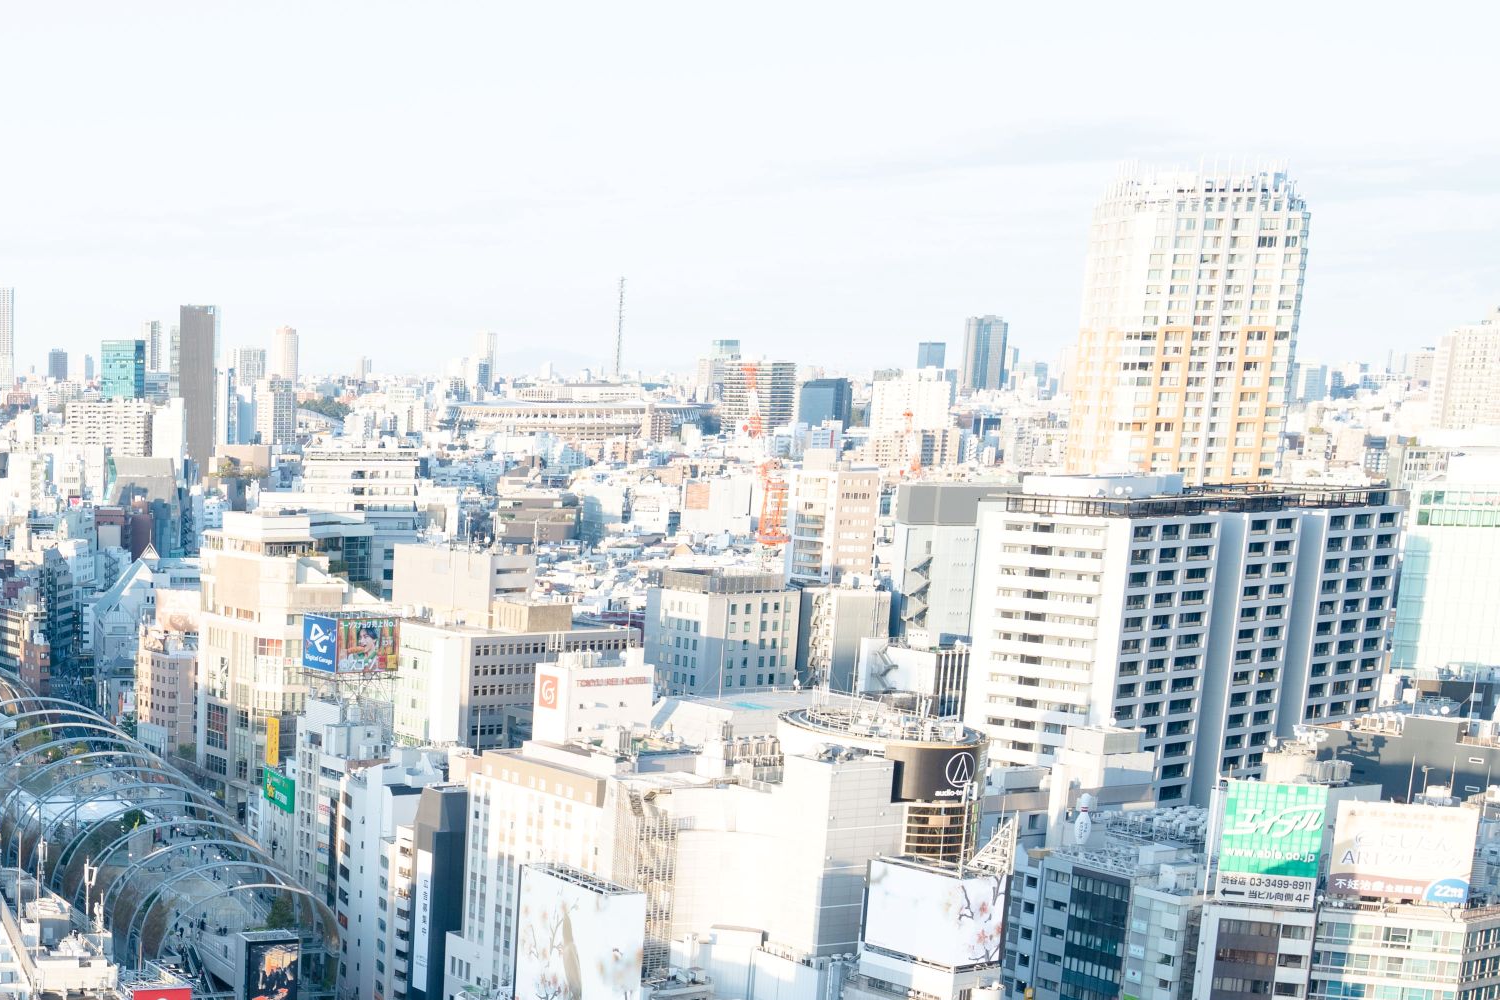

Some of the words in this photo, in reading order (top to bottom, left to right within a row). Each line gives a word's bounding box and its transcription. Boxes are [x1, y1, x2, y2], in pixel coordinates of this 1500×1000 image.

[935, 789, 965, 797] audio-te
[1225, 847, 1315, 863] www.able.co.jp
[1221, 876, 1246, 886] 渋谷店
[1250, 878, 1312, 890] 03-3499-8911
[1335, 878, 1385, 891] 不妊治療
[1249, 889, 1293, 901] 当ビル向側
[1294, 892, 1310, 903] 4F
